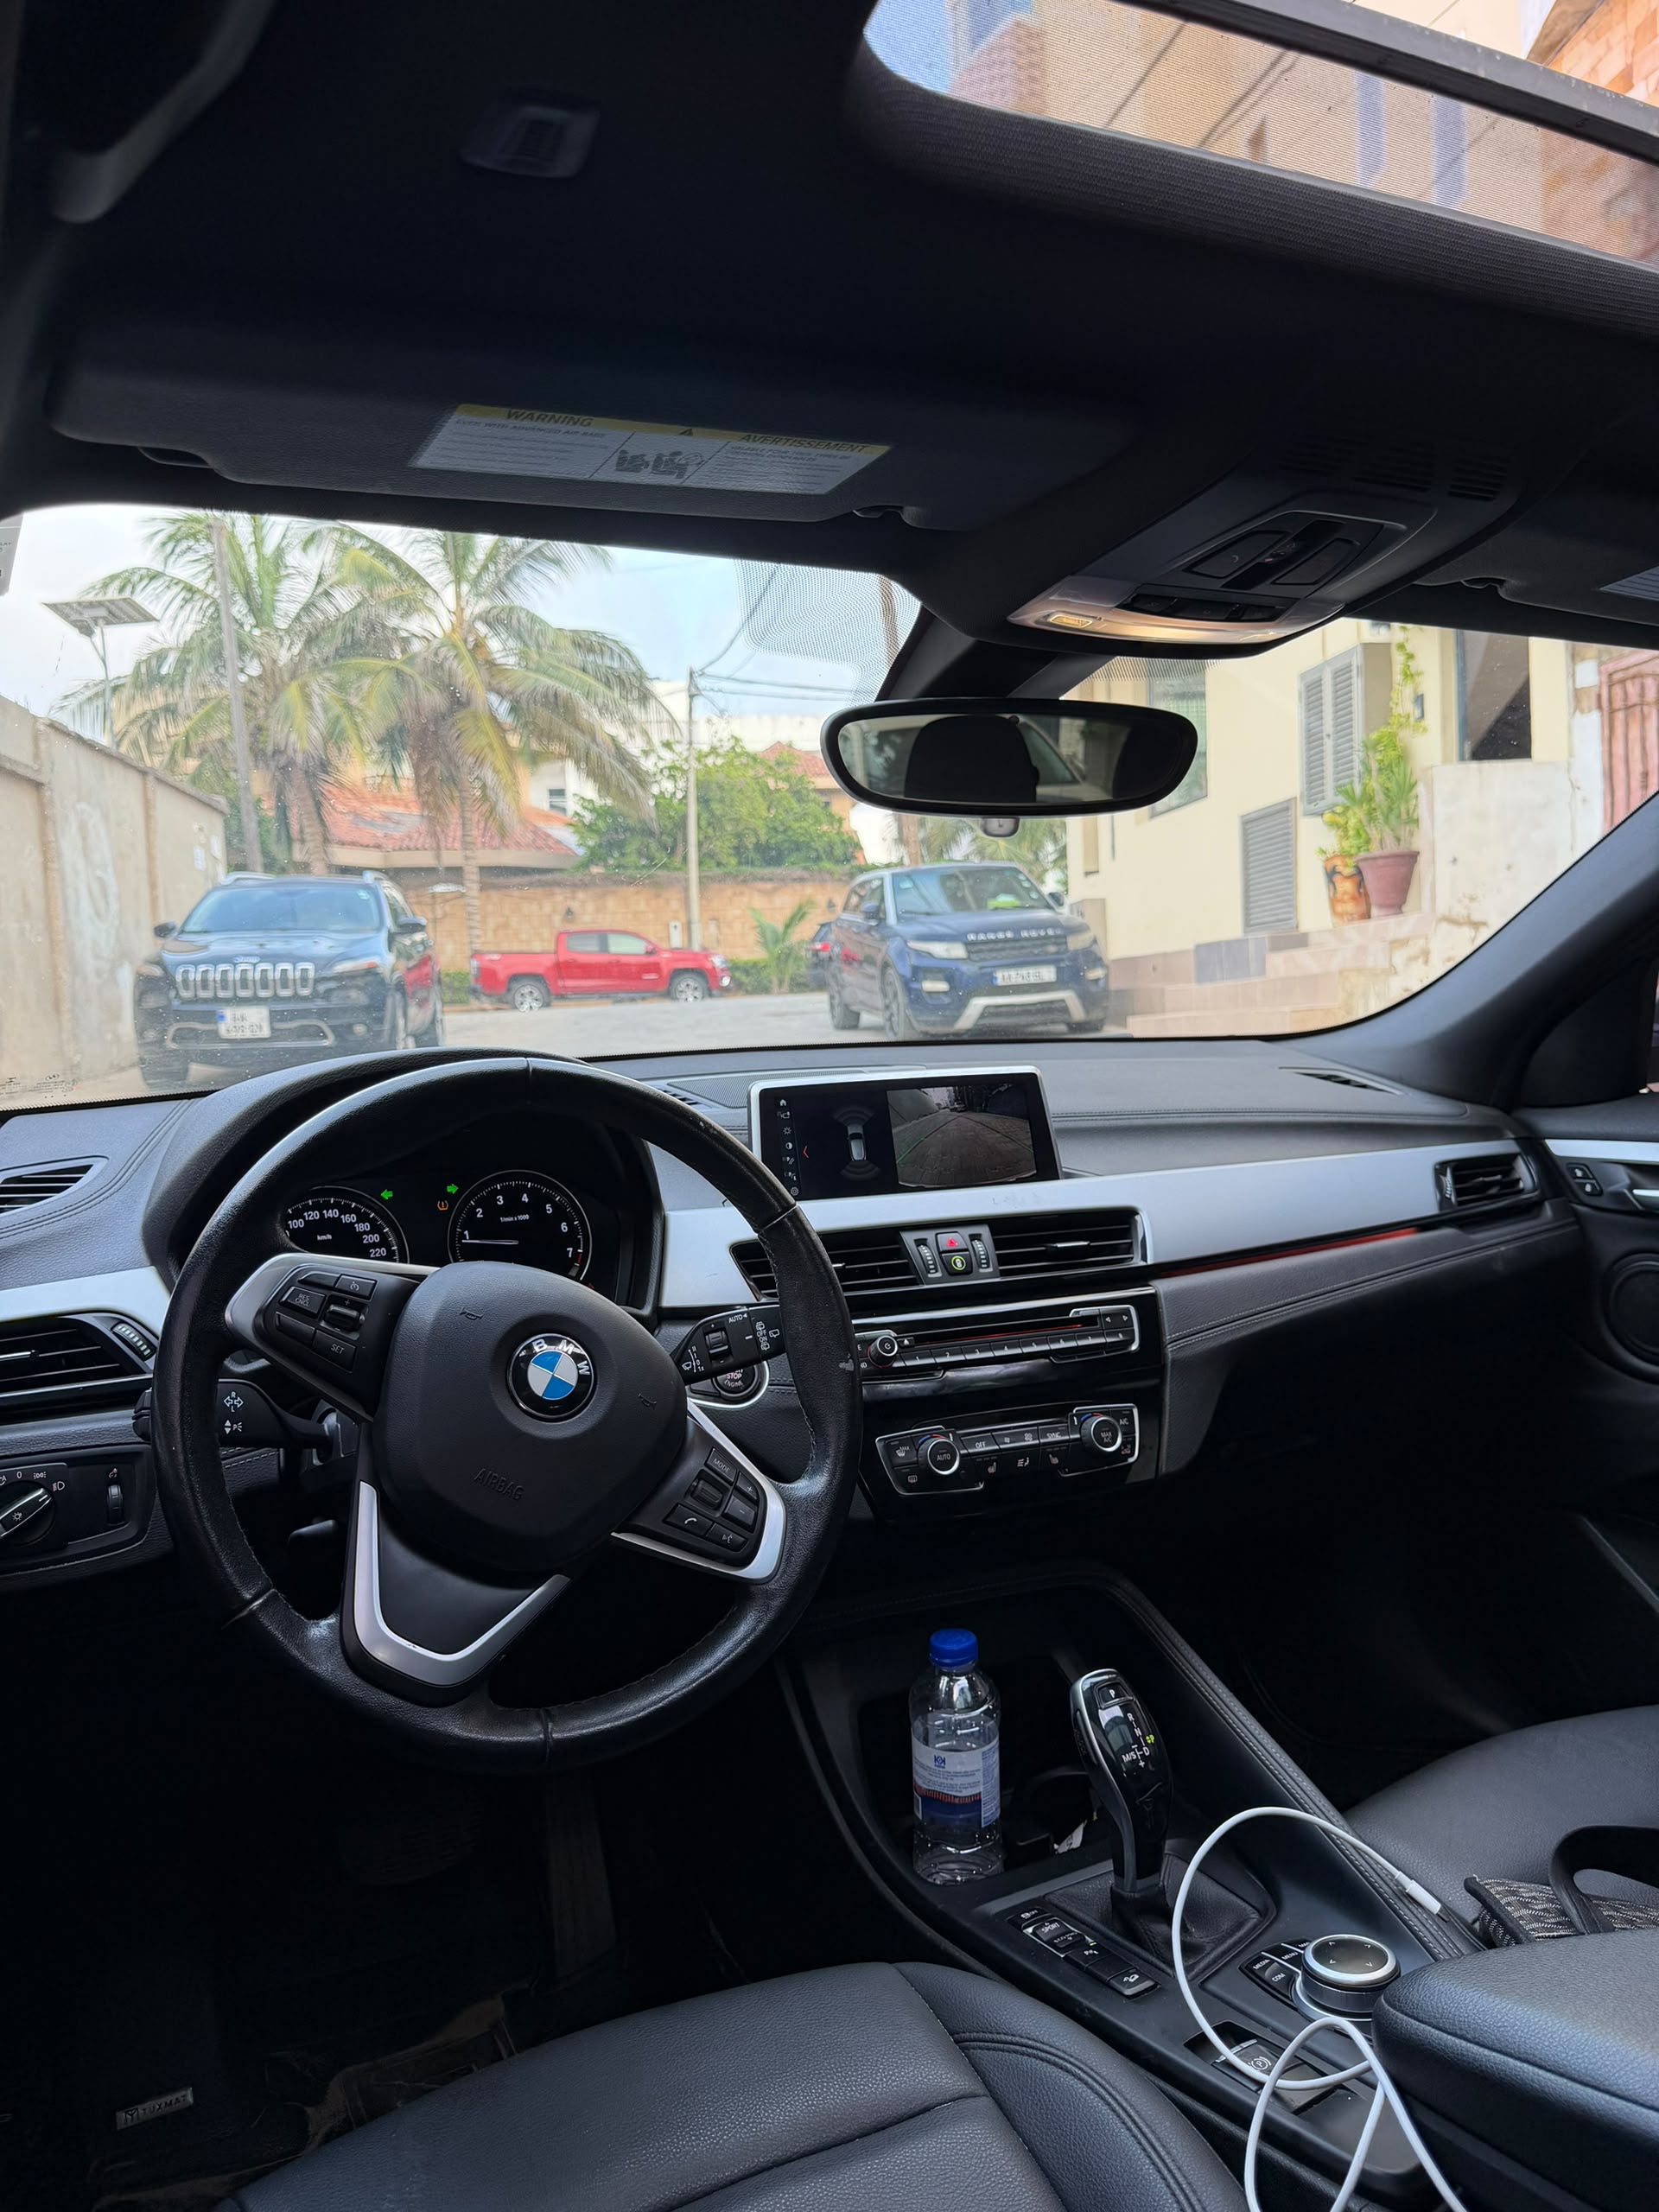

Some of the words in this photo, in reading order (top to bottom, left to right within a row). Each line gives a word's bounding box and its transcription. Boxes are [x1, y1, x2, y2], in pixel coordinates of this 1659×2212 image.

[507, 410, 594, 427] WARNING
[741, 434, 870, 453] AVERTISSEMENT
[496, 1195, 504, 1205] 3
[521, 1193, 529, 1203] 4
[322, 1209, 339, 1219] 140
[476, 1208, 483, 1217] 2
[545, 1204, 553, 1214] 5
[303, 1211, 320, 1221] 120
[340, 1213, 357, 1224] 160
[288, 1218, 304, 1229] 100
[354, 1222, 371, 1232] 180
[561, 1222, 568, 1232] 6
[362, 1234, 379, 1243] 200
[463, 1230, 469, 1240] 1
[369, 1248, 386, 1258] 220
[567, 1247, 573, 1257] 7
[728, 1313, 743, 1323] AUTO
[331, 1344, 345, 1355] SET
[532, 1338, 590, 1376] BMW
[975, 1440, 987, 1449] OFF
[713, 1458, 730, 1472] MODE
[474, 1468, 525, 1500] AIRBAG
[1109, 1688, 1116, 1699] P
[1127, 1713, 1134, 1722] R
[1134, 1727, 1142, 1737] N
[1142, 1746, 1150, 1757] D
[1122, 1751, 1136, 1763] M/S
[1041, 1922, 1060, 1934] SPORT
[1253, 1959, 1271, 1970] MEDIA
[1271, 1973, 1286, 1982] COM
[141, 2094, 188, 2117] TUXMAT
